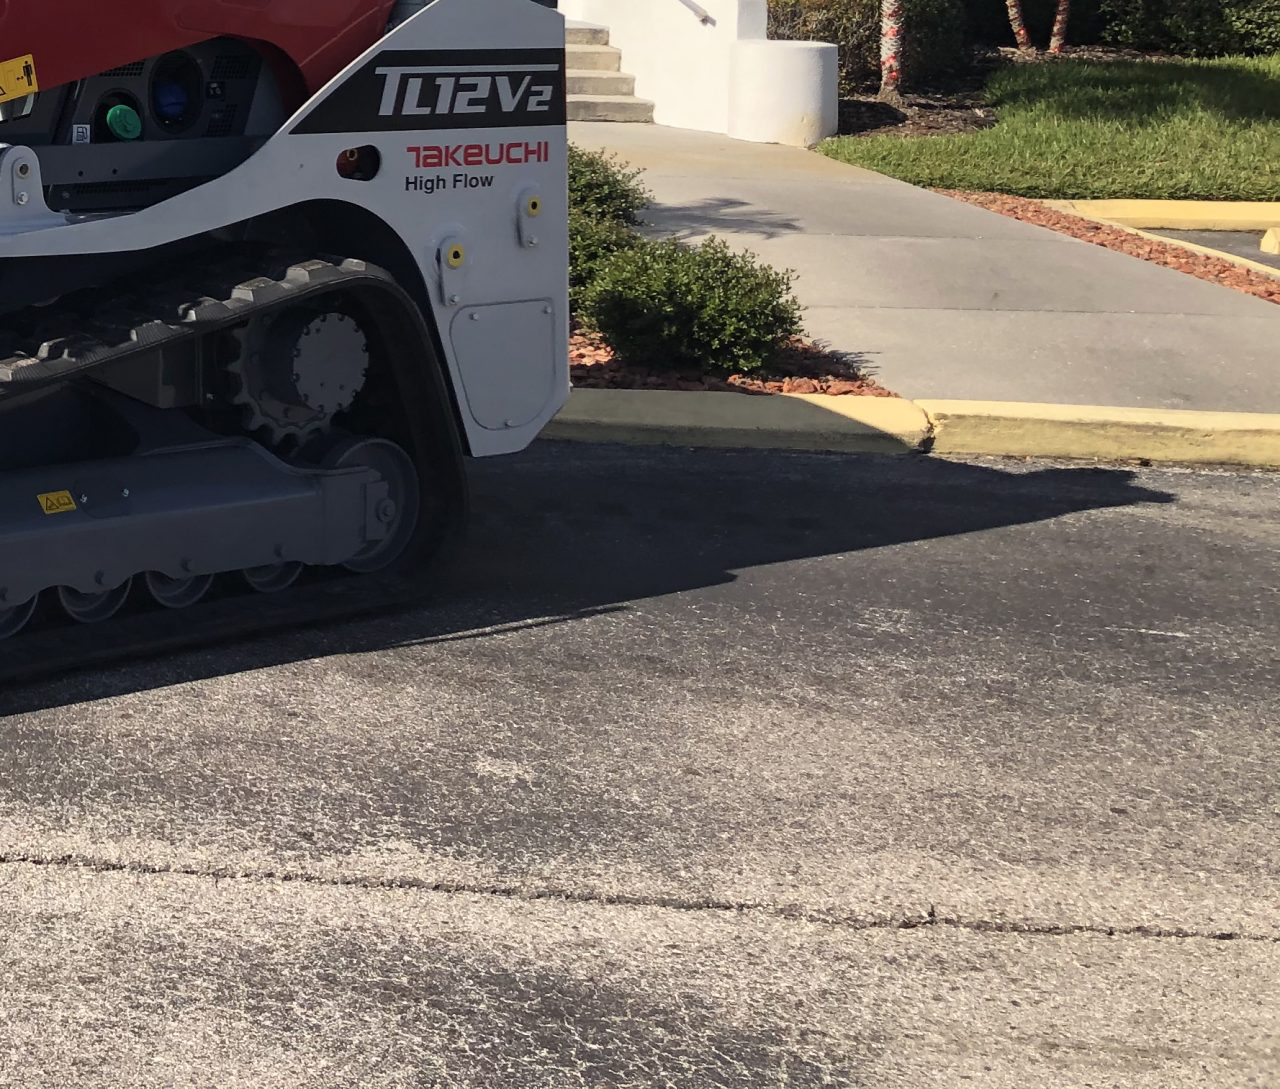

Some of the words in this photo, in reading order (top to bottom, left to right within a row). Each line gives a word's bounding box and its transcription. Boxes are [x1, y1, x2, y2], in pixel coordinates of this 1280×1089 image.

[375, 64, 559, 116] TL12V2
[407, 141, 549, 168] TAKEUCHI
[404, 176, 446, 194] High
[452, 173, 494, 189] Flow
